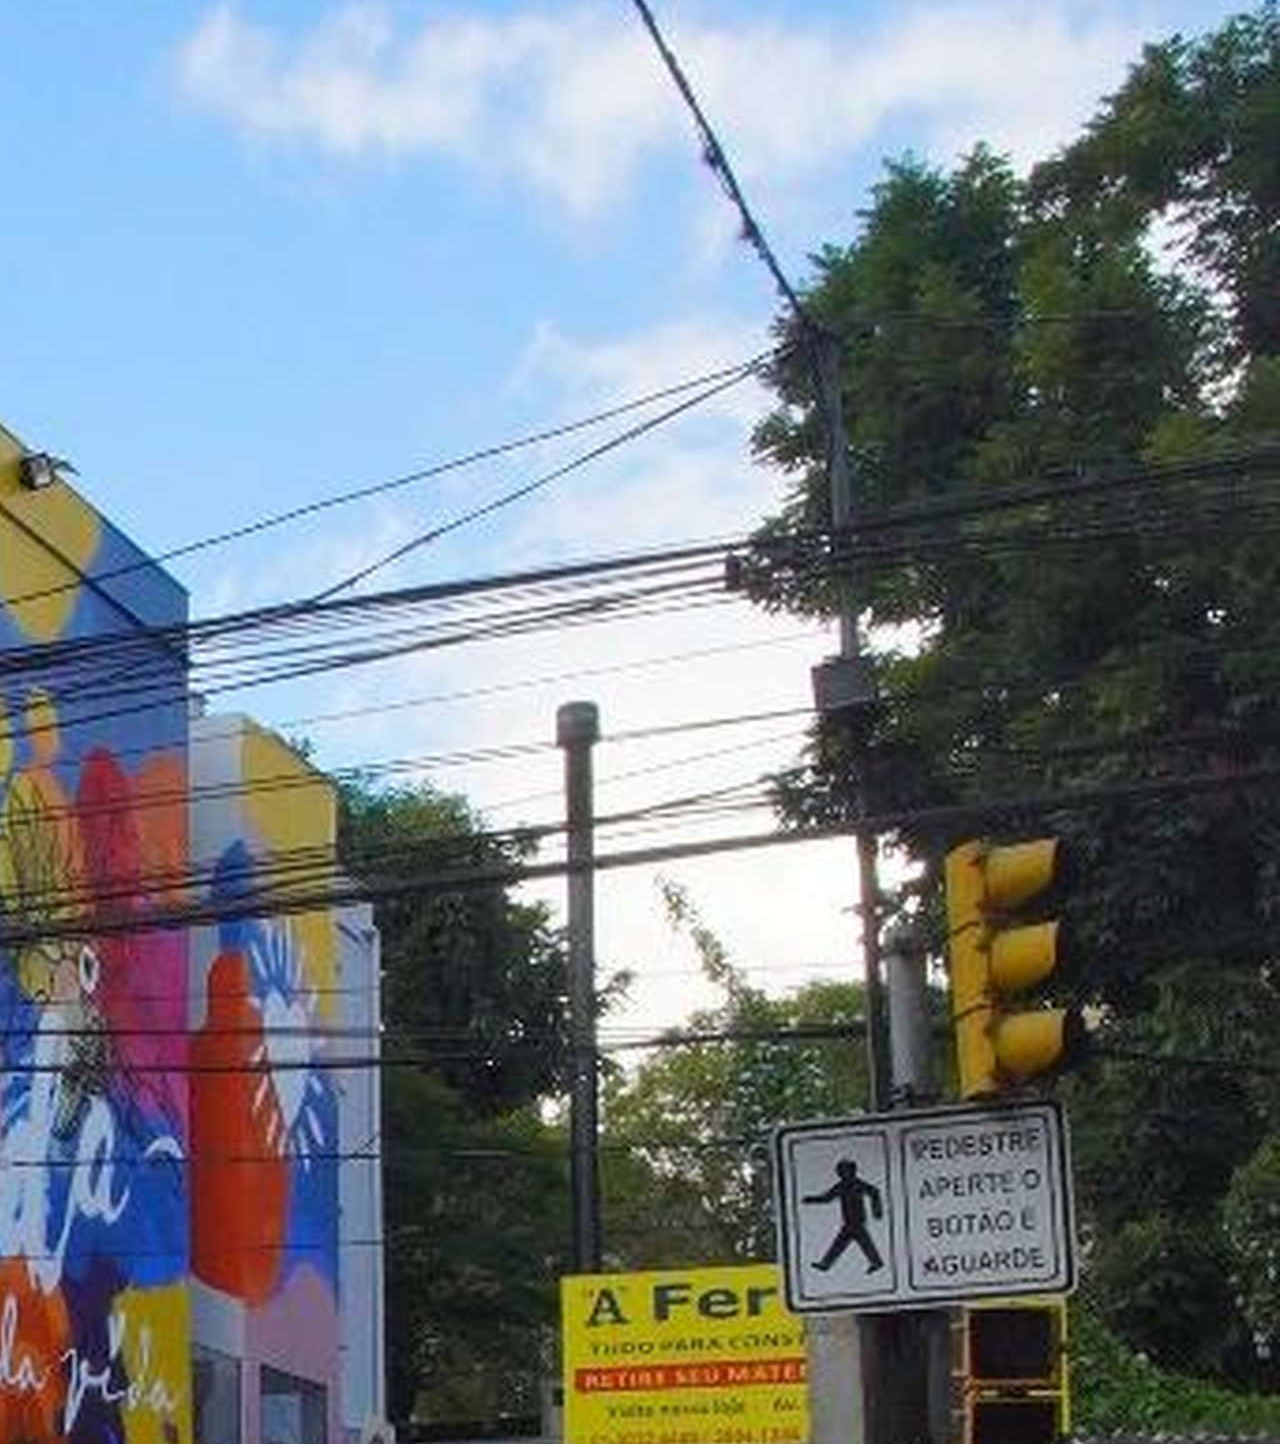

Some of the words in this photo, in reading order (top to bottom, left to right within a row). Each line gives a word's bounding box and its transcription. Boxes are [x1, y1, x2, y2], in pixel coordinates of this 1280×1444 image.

[911, 1127, 1041, 1160] PEDESTRE
[919, 1170, 1015, 1200] APERTE
[1022, 1167, 1041, 1190] O
[926, 1207, 1015, 1239] BOTÃO
[923, 1246, 1046, 1277] AGUARDE
[60, 1311, 176, 1436] vida
